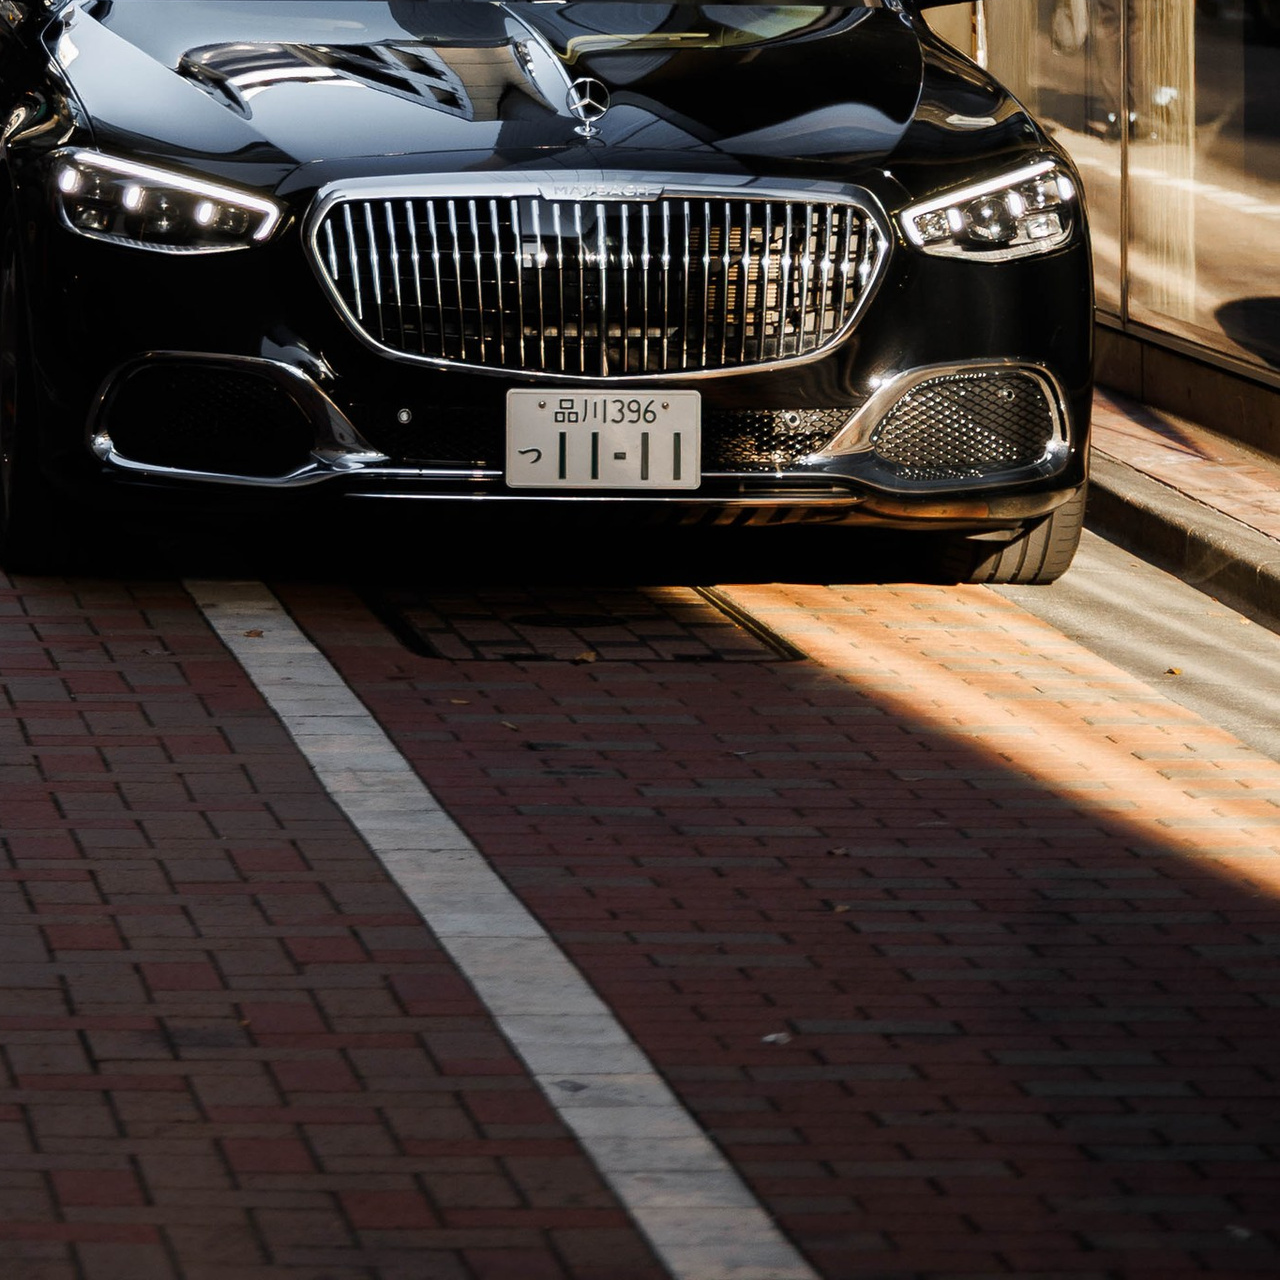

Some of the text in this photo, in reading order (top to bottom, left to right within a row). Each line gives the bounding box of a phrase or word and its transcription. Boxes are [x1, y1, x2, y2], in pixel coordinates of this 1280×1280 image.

[553, 185, 649, 197] MAYBACH
[518, 432, 682, 480] つ 11-11
